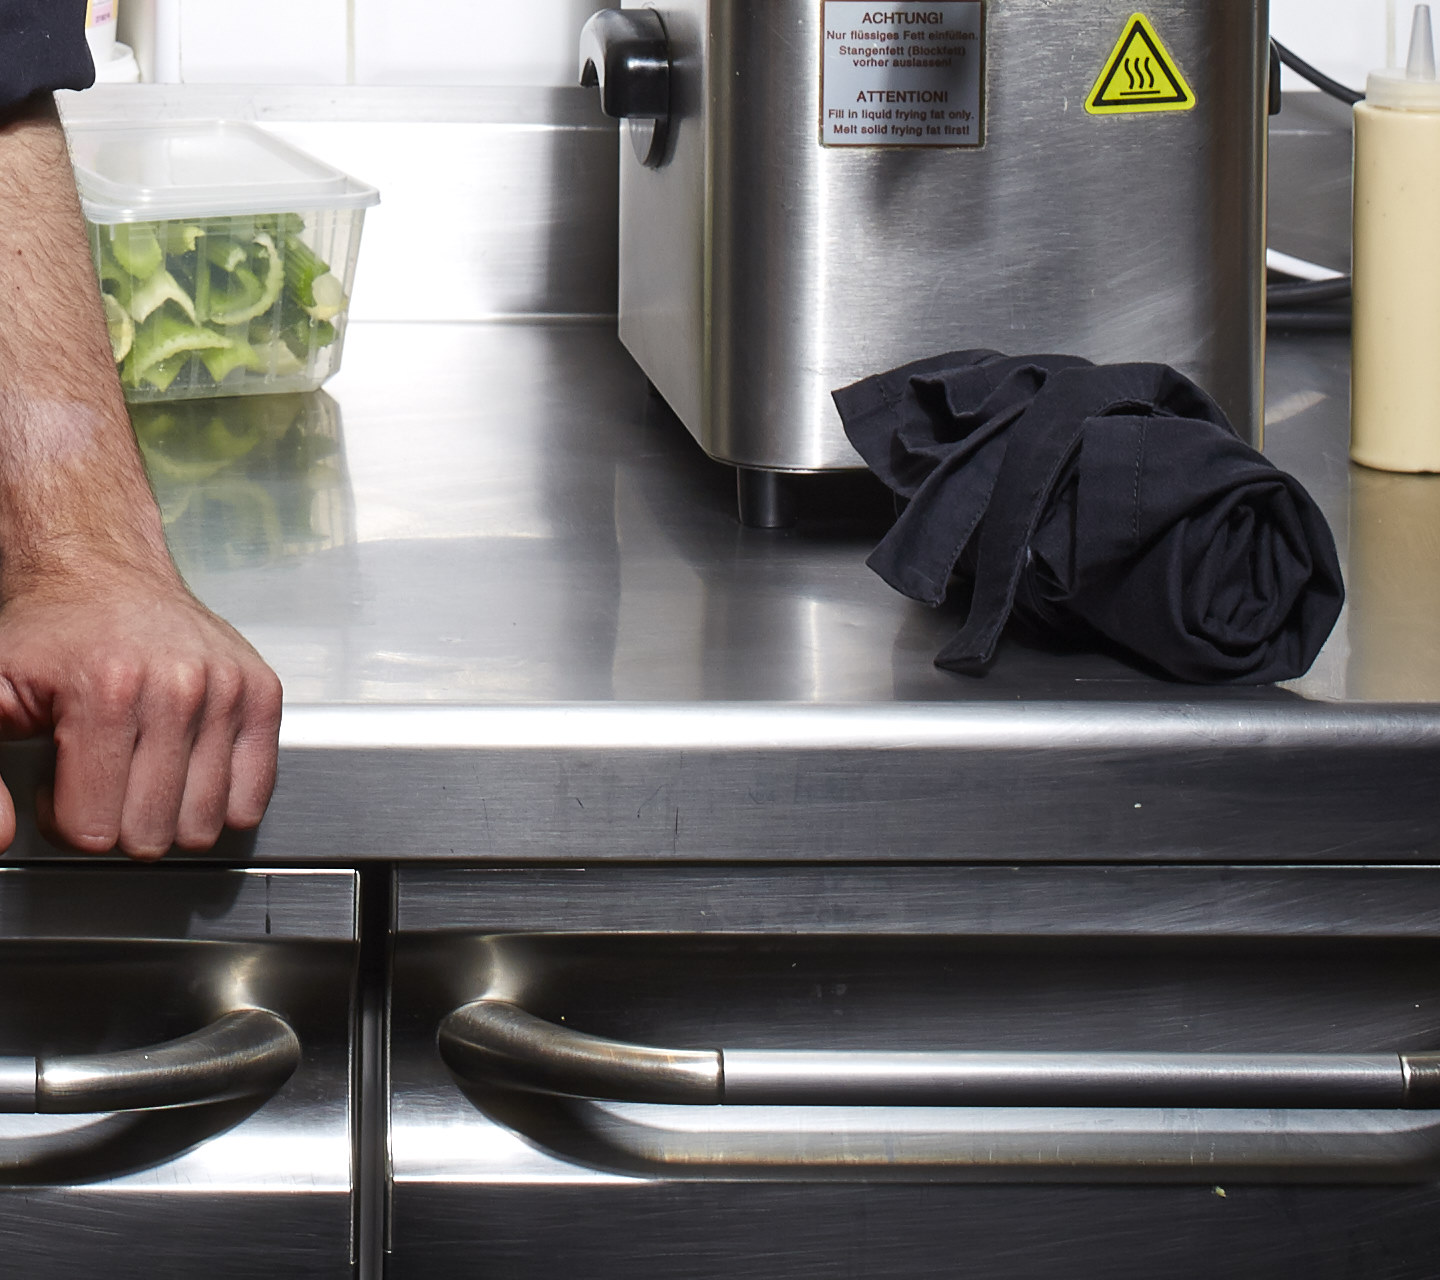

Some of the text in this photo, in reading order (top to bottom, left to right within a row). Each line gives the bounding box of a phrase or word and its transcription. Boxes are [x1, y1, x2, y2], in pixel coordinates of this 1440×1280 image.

[862, 11, 943, 25] ACHTUNG!
[826, 30, 846, 40] Nur
[850, 30, 899, 43] flüssiges
[903, 30, 925, 40] Fett
[839, 45, 966, 57] Stangenfett (Blockfett)
[852, 57, 953, 67] vorher auslassen!
[856, 90, 948, 103] ATTENTION!
[828, 108, 975, 121] Fill in liquid frying fat only.
[833, 124, 970, 137] Melt solid frying fat first!
